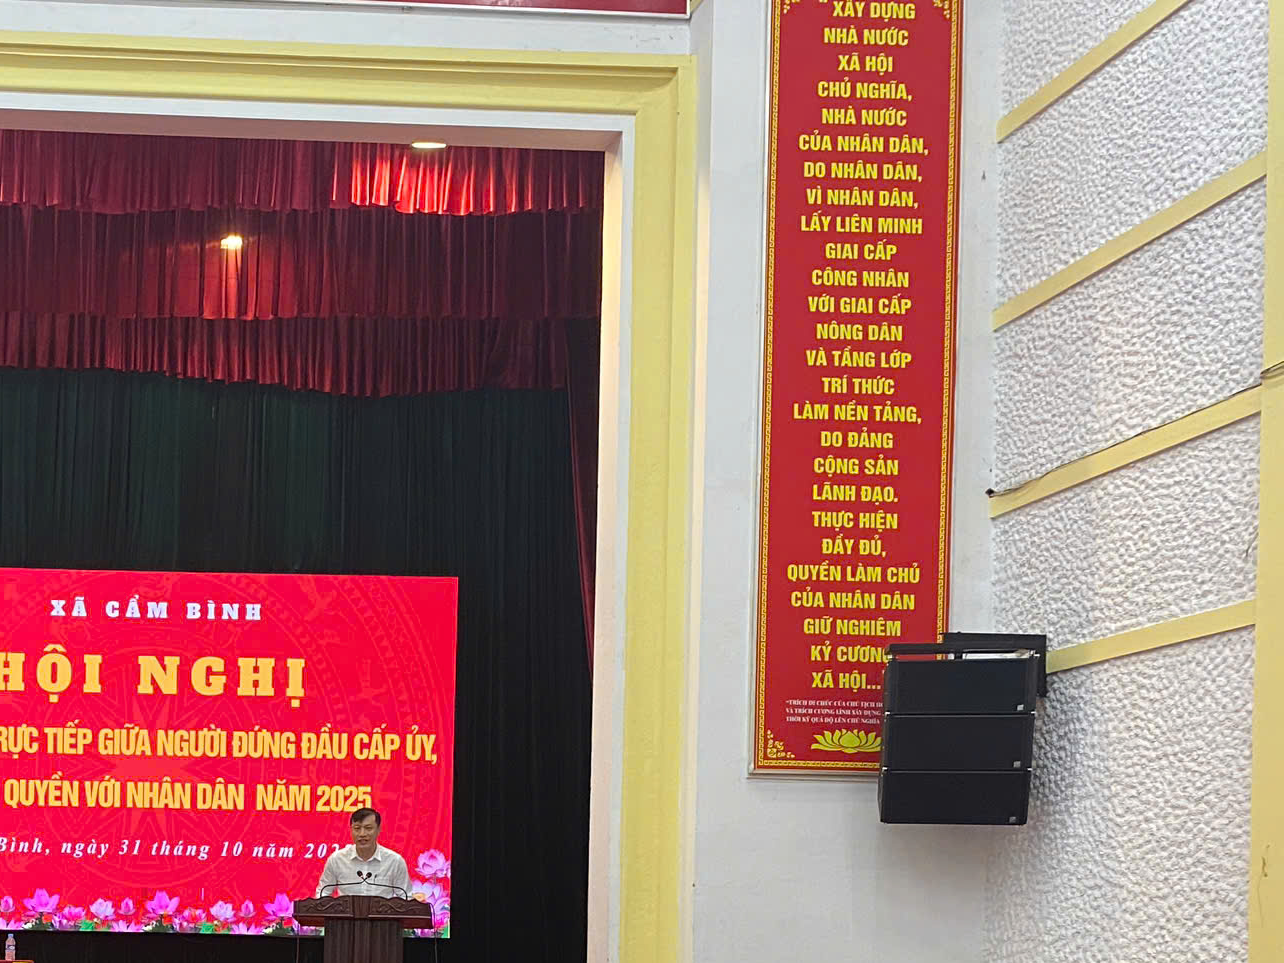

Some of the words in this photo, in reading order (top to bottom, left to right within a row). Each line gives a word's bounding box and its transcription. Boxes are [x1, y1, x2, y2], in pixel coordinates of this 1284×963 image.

[823, 24, 859, 45] NHÀ
[863, 26, 909, 46] NƯỚC
[837, 52, 861, 72] XÃ
[865, 54, 893, 76] HỘI
[817, 77, 852, 98] CHỦ
[855, 80, 913, 102] NGHĨA,
[798, 130, 833, 152] CỦA
[837, 133, 885, 153] NHÂN
[889, 135, 929, 155] DÂN,
[806, 186, 822, 205] VÌ
[826, 187, 874, 206] NHÂN
[878, 187, 917, 209] DÂN,
[800, 210, 831, 232] LẤY
[835, 214, 873, 233] LIÊN
[877, 217, 923, 235] MINH
[811, 267, 858, 287] CÔNG
[862, 268, 909, 288] NHÂN
[807, 294, 835, 313] VỚI
[839, 296, 874, 314] GIAI
[878, 293, 912, 315] CẤP
[805, 347, 828, 367] VÀ
[831, 346, 876, 368] TẦNG
[880, 349, 912, 369] LỚP
[793, 401, 829, 420] LÀM
[834, 399, 869, 421] NỀN
[873, 401, 922, 424] TẢNG,
[820, 431, 843, 448] DO
[847, 428, 894, 449] ĐẢNG
[812, 481, 857, 502] LÃNH
[860, 485, 899, 506] ĐẠO.
[811, 511, 854, 532] THỰC
[859, 511, 898, 533] HIỆN
[786, 560, 842, 583] QUYỀN
[846, 564, 883, 584] LÀM
[886, 562, 921, 585] CHỦ
[51, 594, 87, 618] XÃ
[105, 593, 168, 620] CẨM
[187, 599, 262, 622] BÌNH
[803, 615, 833, 635] GIỮ
[836, 616, 901, 637] NGHIÊM
[810, 640, 832, 662] KỶ
[137, 656, 307, 708] NGHỊ
[811, 669, 834, 689] XÃ
[44, 718, 93, 754] TIẾP
[97, 723, 151, 756] GIỮA
[157, 723, 227, 758] NGƯỜI
[232, 723, 295, 759] ĐỨNG
[300, 719, 348, 760] ĐẦU
[352, 723, 400, 762] CẤP
[405, 724, 438, 765] ỦY,
[4, 773, 79, 810] QUYỀN
[84, 776, 122, 809] VỚI
[126, 775, 191, 810] NHÂN
[196, 777, 244, 810] DÂN
[255, 779, 310, 811] NĂM
[316, 784, 372, 812] 2025
[59, 838, 111, 859] ngày
[119, 838, 142, 855] 31
[151, 837, 211, 859] tháng
[220, 840, 243, 857] 10
[253, 840, 295, 858] năm
